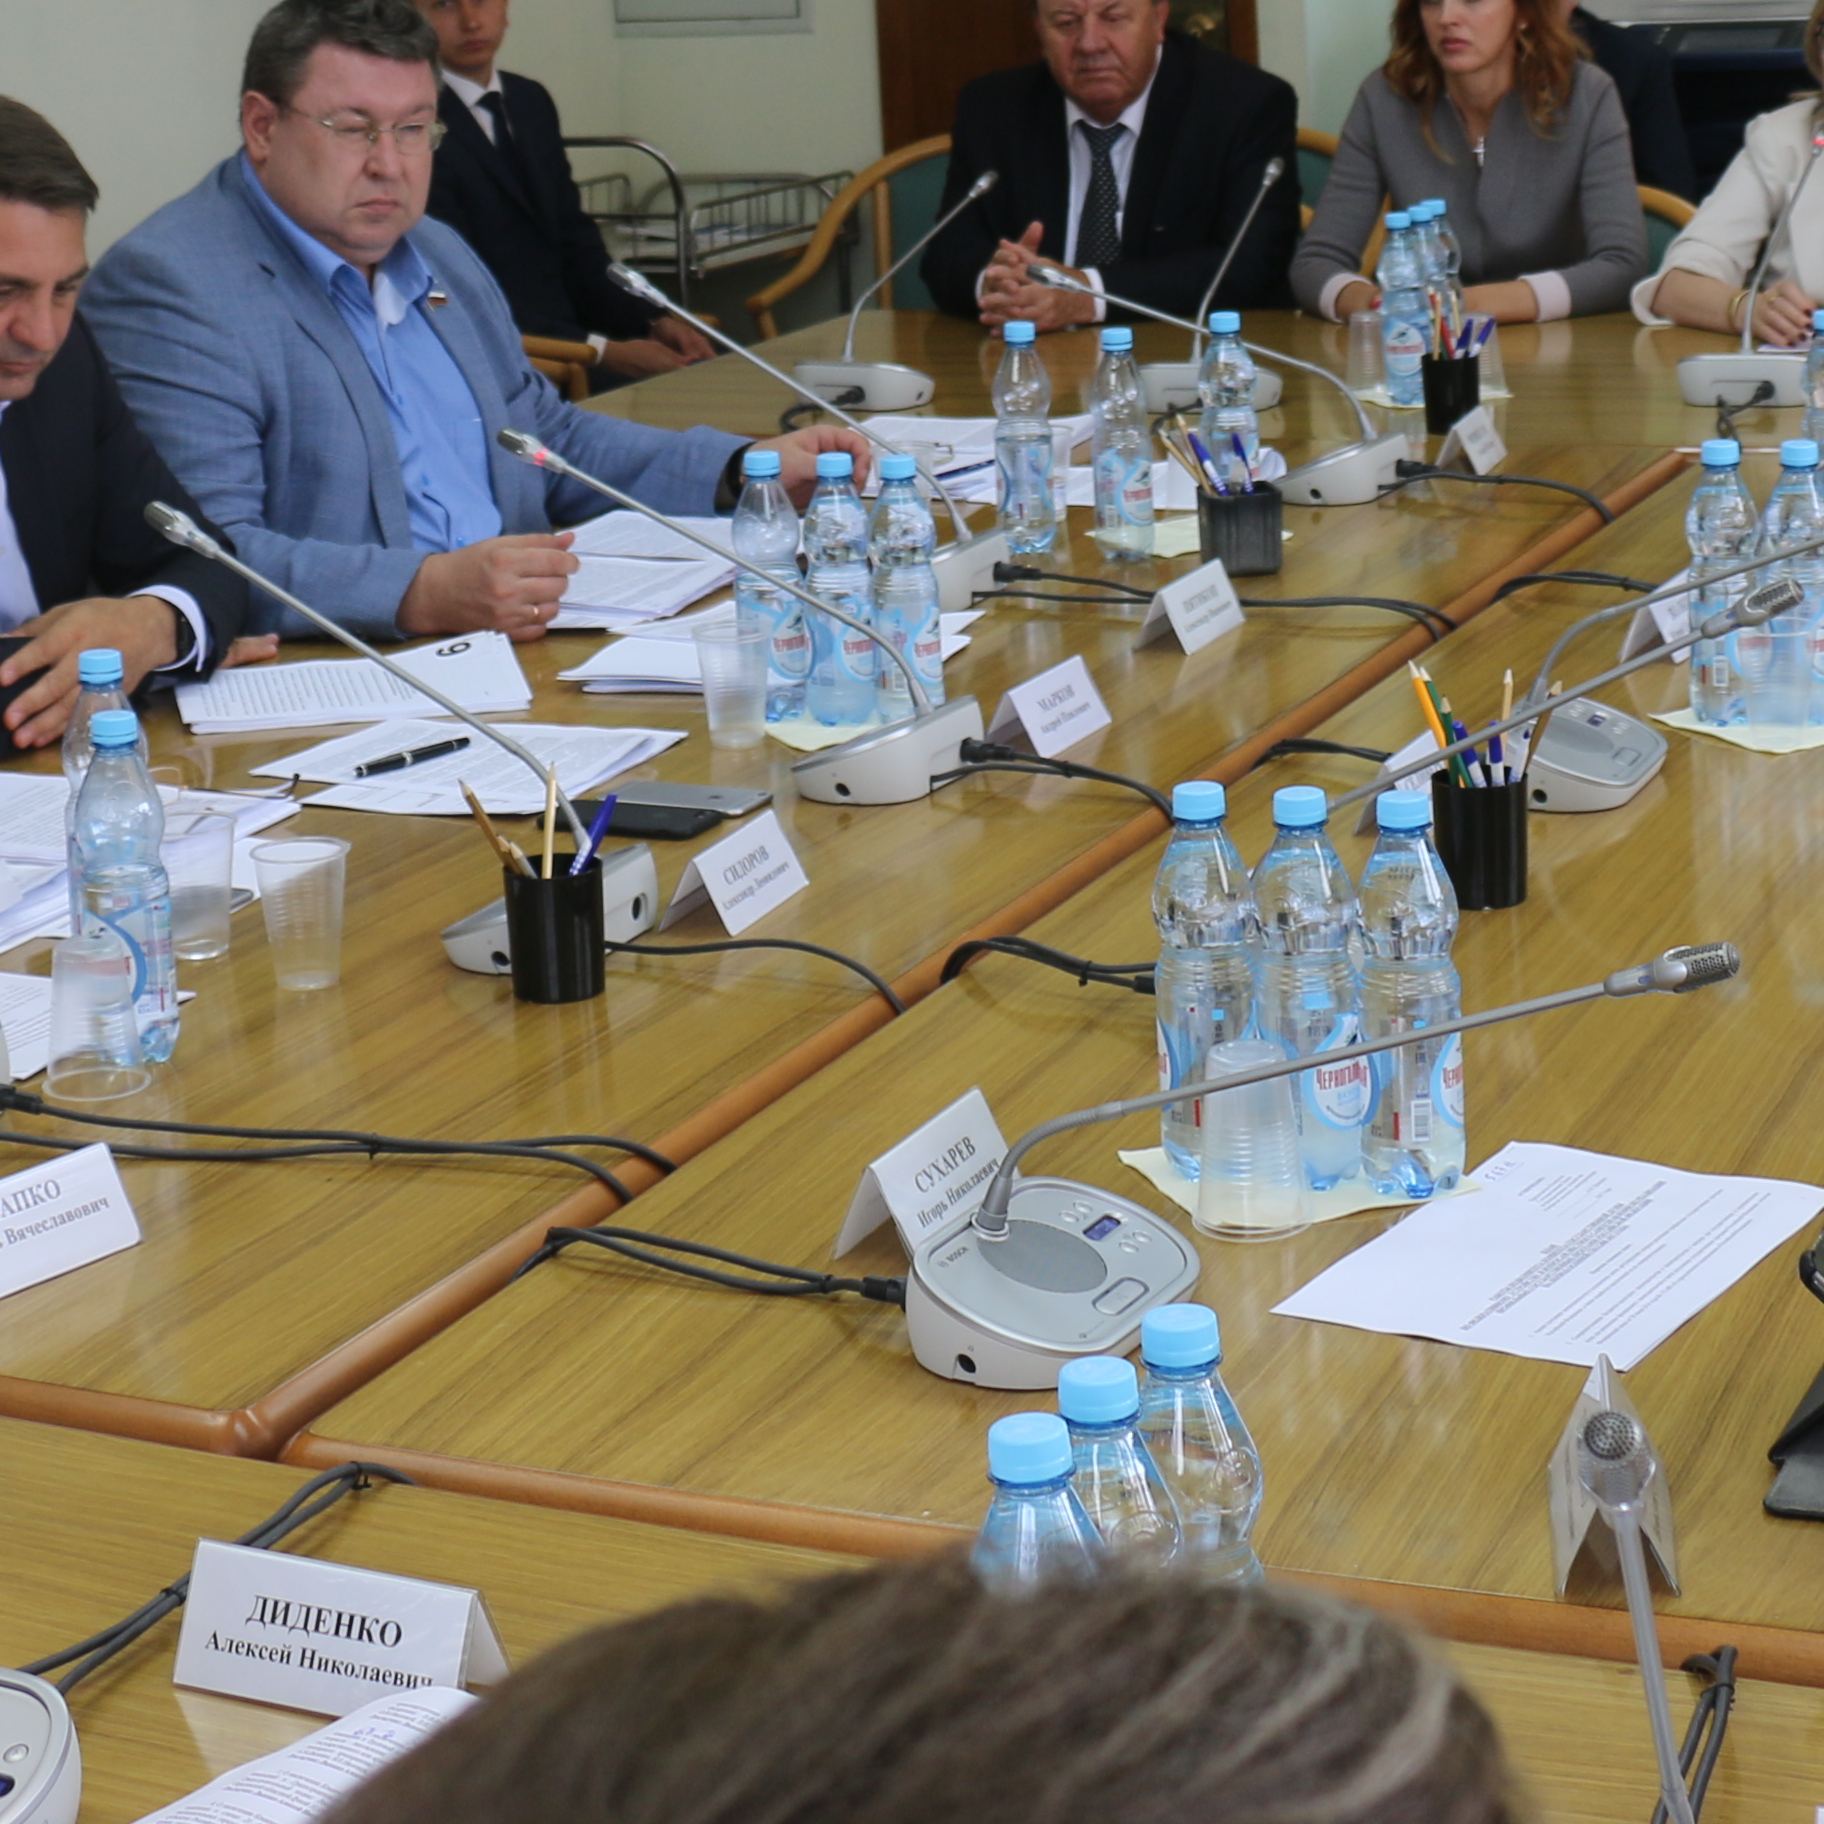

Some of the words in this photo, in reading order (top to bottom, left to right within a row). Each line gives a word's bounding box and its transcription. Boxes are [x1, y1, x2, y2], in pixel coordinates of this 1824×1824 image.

[914, 1136, 976, 1193] СУХАРЕВ
[4, 1194, 112, 1246] Вячеславович
[917, 1201, 949, 1228] Игорь
[205, 1629, 294, 1666] Алексей
[244, 1594, 403, 1649] ДИДЕНКО
